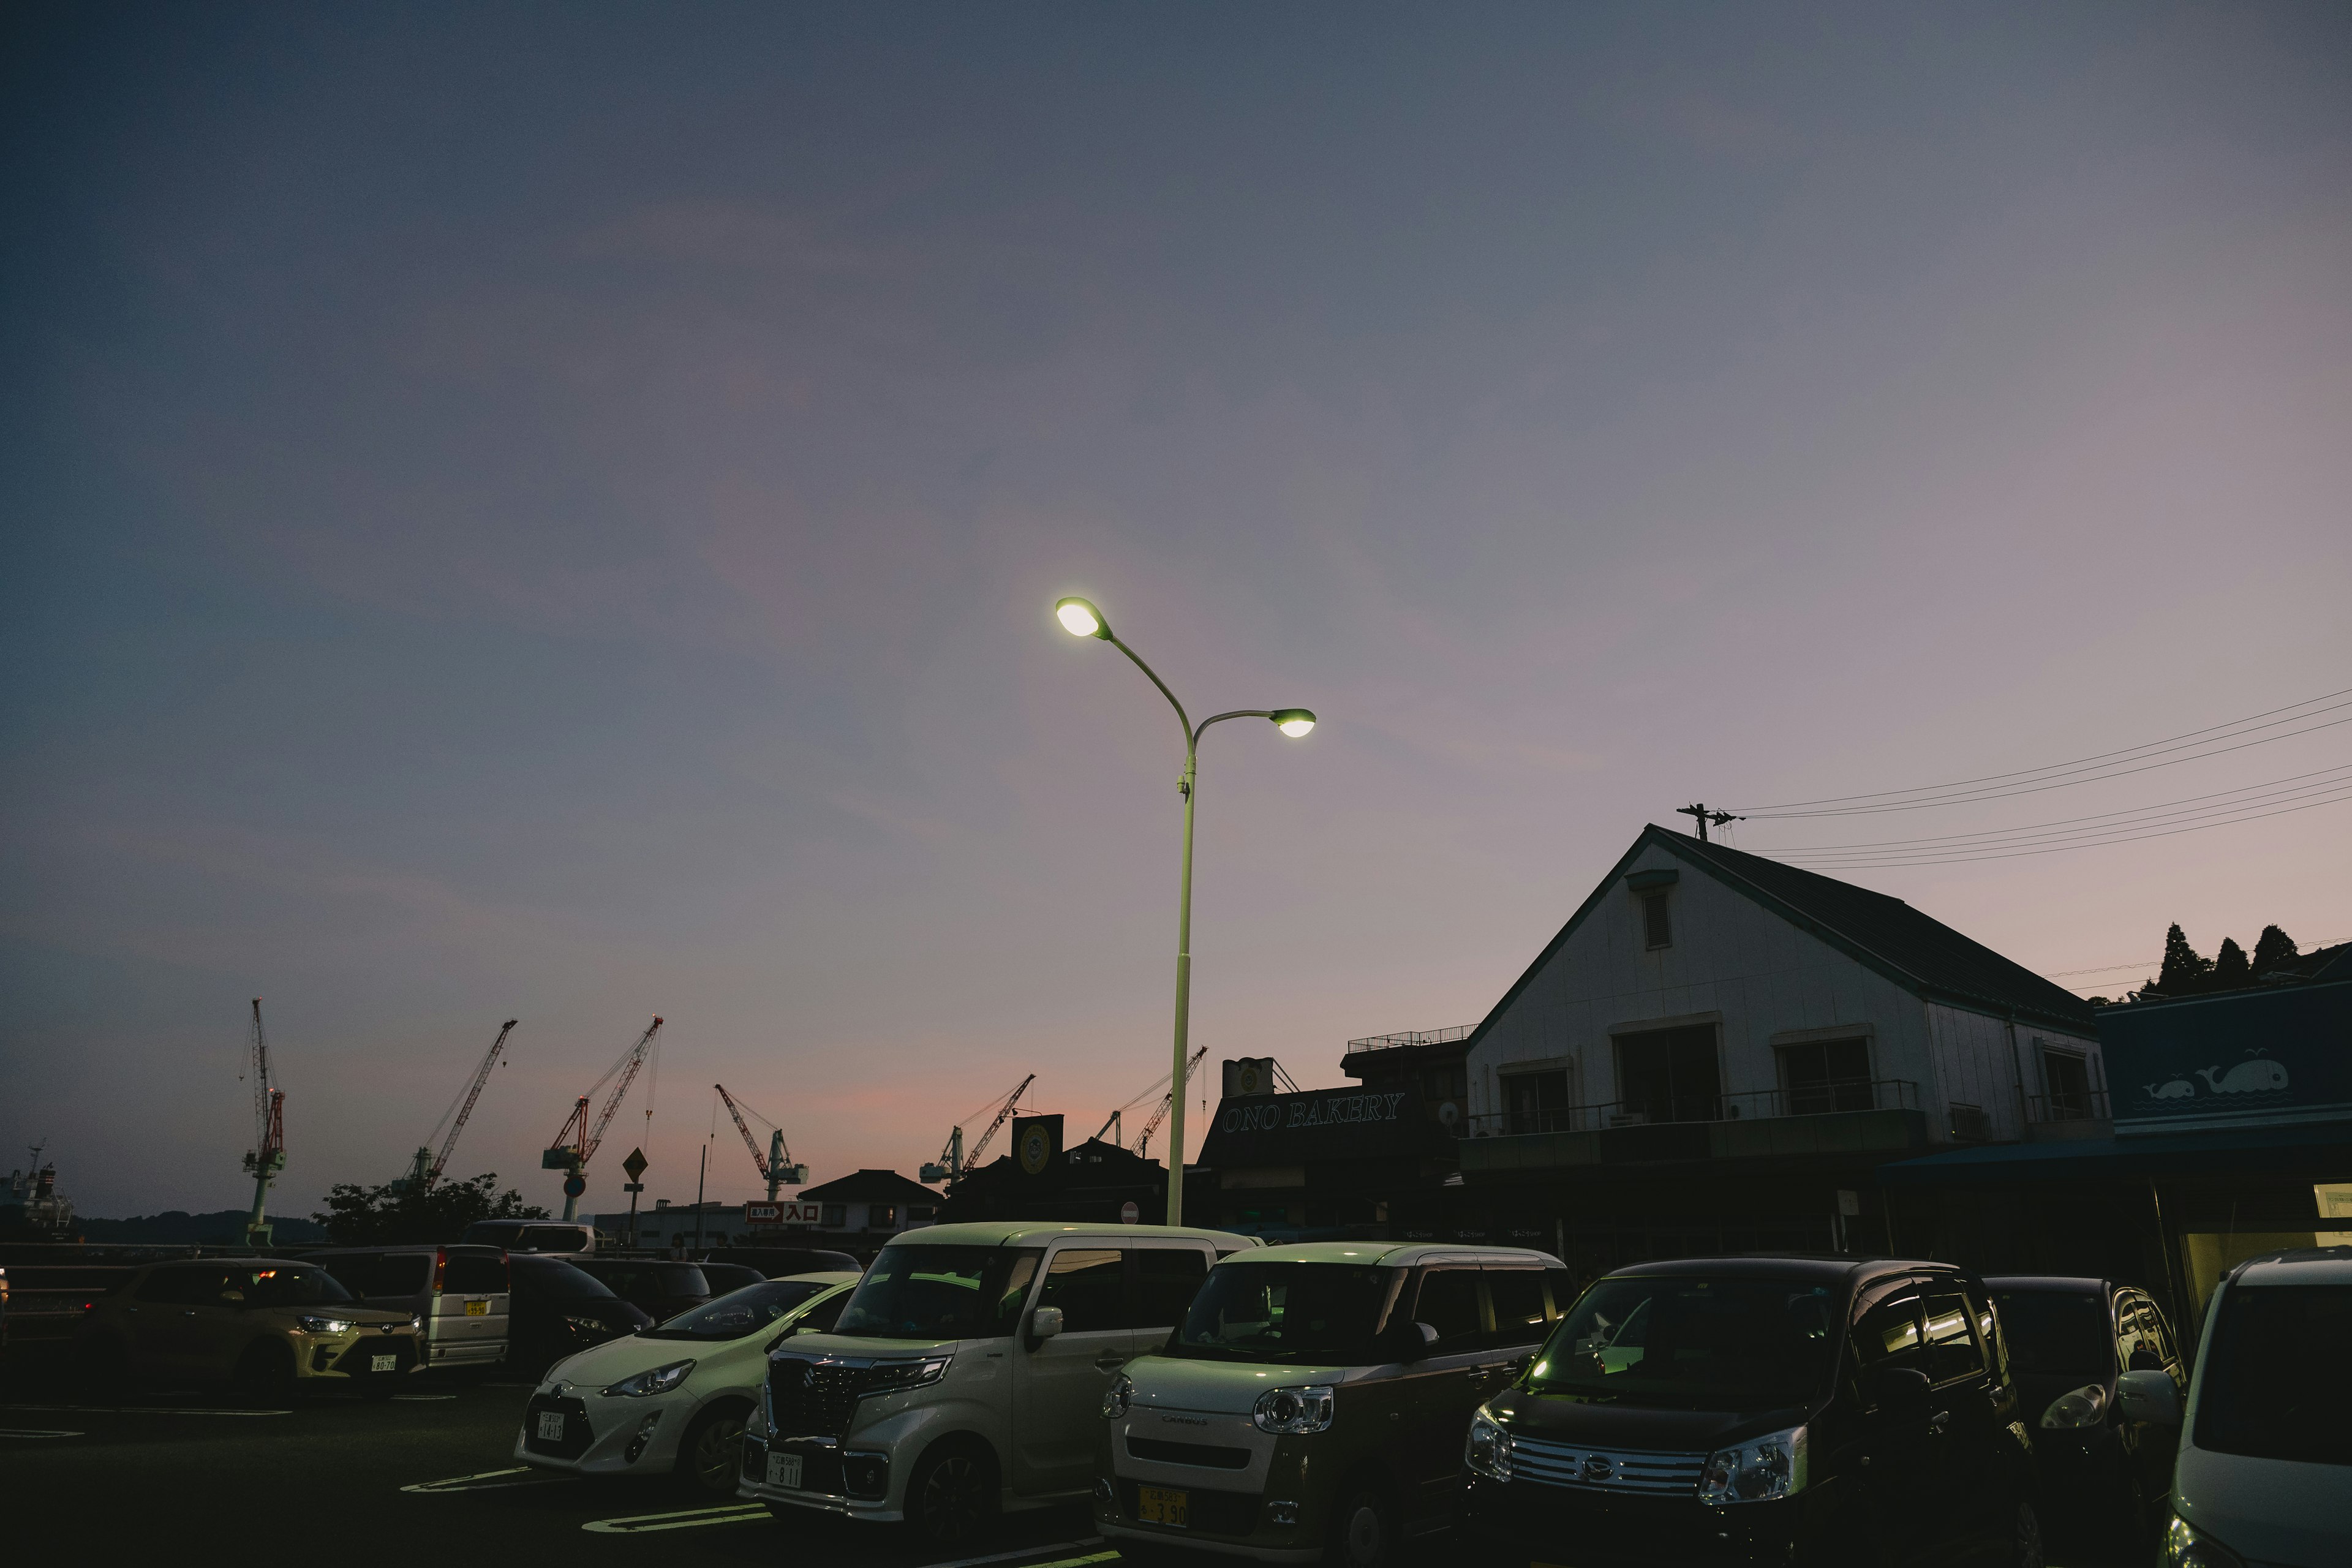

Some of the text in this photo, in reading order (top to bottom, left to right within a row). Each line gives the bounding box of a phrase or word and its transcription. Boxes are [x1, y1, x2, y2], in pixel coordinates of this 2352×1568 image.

[1223, 1093, 1405, 1133] ONO BAKERY
[786, 1204, 818, 1221] 入口
[377, 1361, 394, 1370] 80-70
[1162, 1415, 1207, 1425] CANBUS
